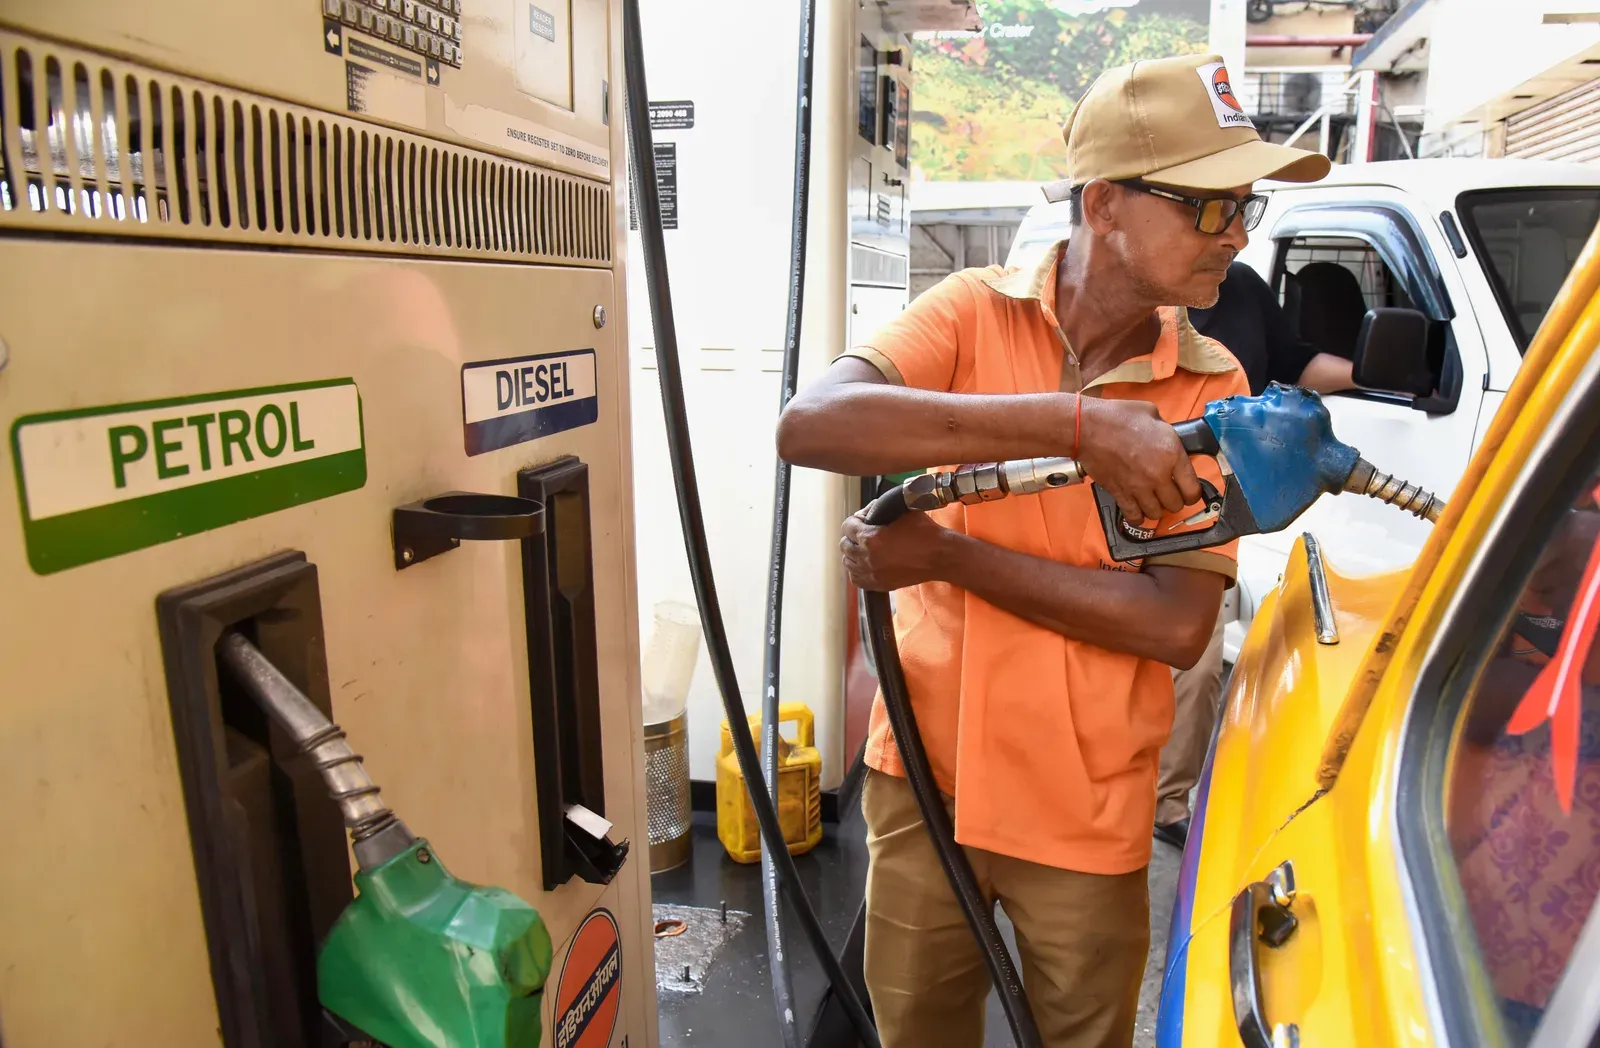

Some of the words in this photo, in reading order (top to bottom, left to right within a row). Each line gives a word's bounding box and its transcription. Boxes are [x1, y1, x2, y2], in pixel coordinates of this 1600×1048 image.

[507, 127, 526, 141] ENSURE
[527, 133, 550, 149] REGISTER
[550, 142, 558, 151] SET
[559, 144, 565, 154] TO
[565, 146, 576, 157] ZERO
[576, 150, 591, 163] BEFORE
[496, 362, 574, 411] DIESEL
[108, 401, 315, 488] PETROL
